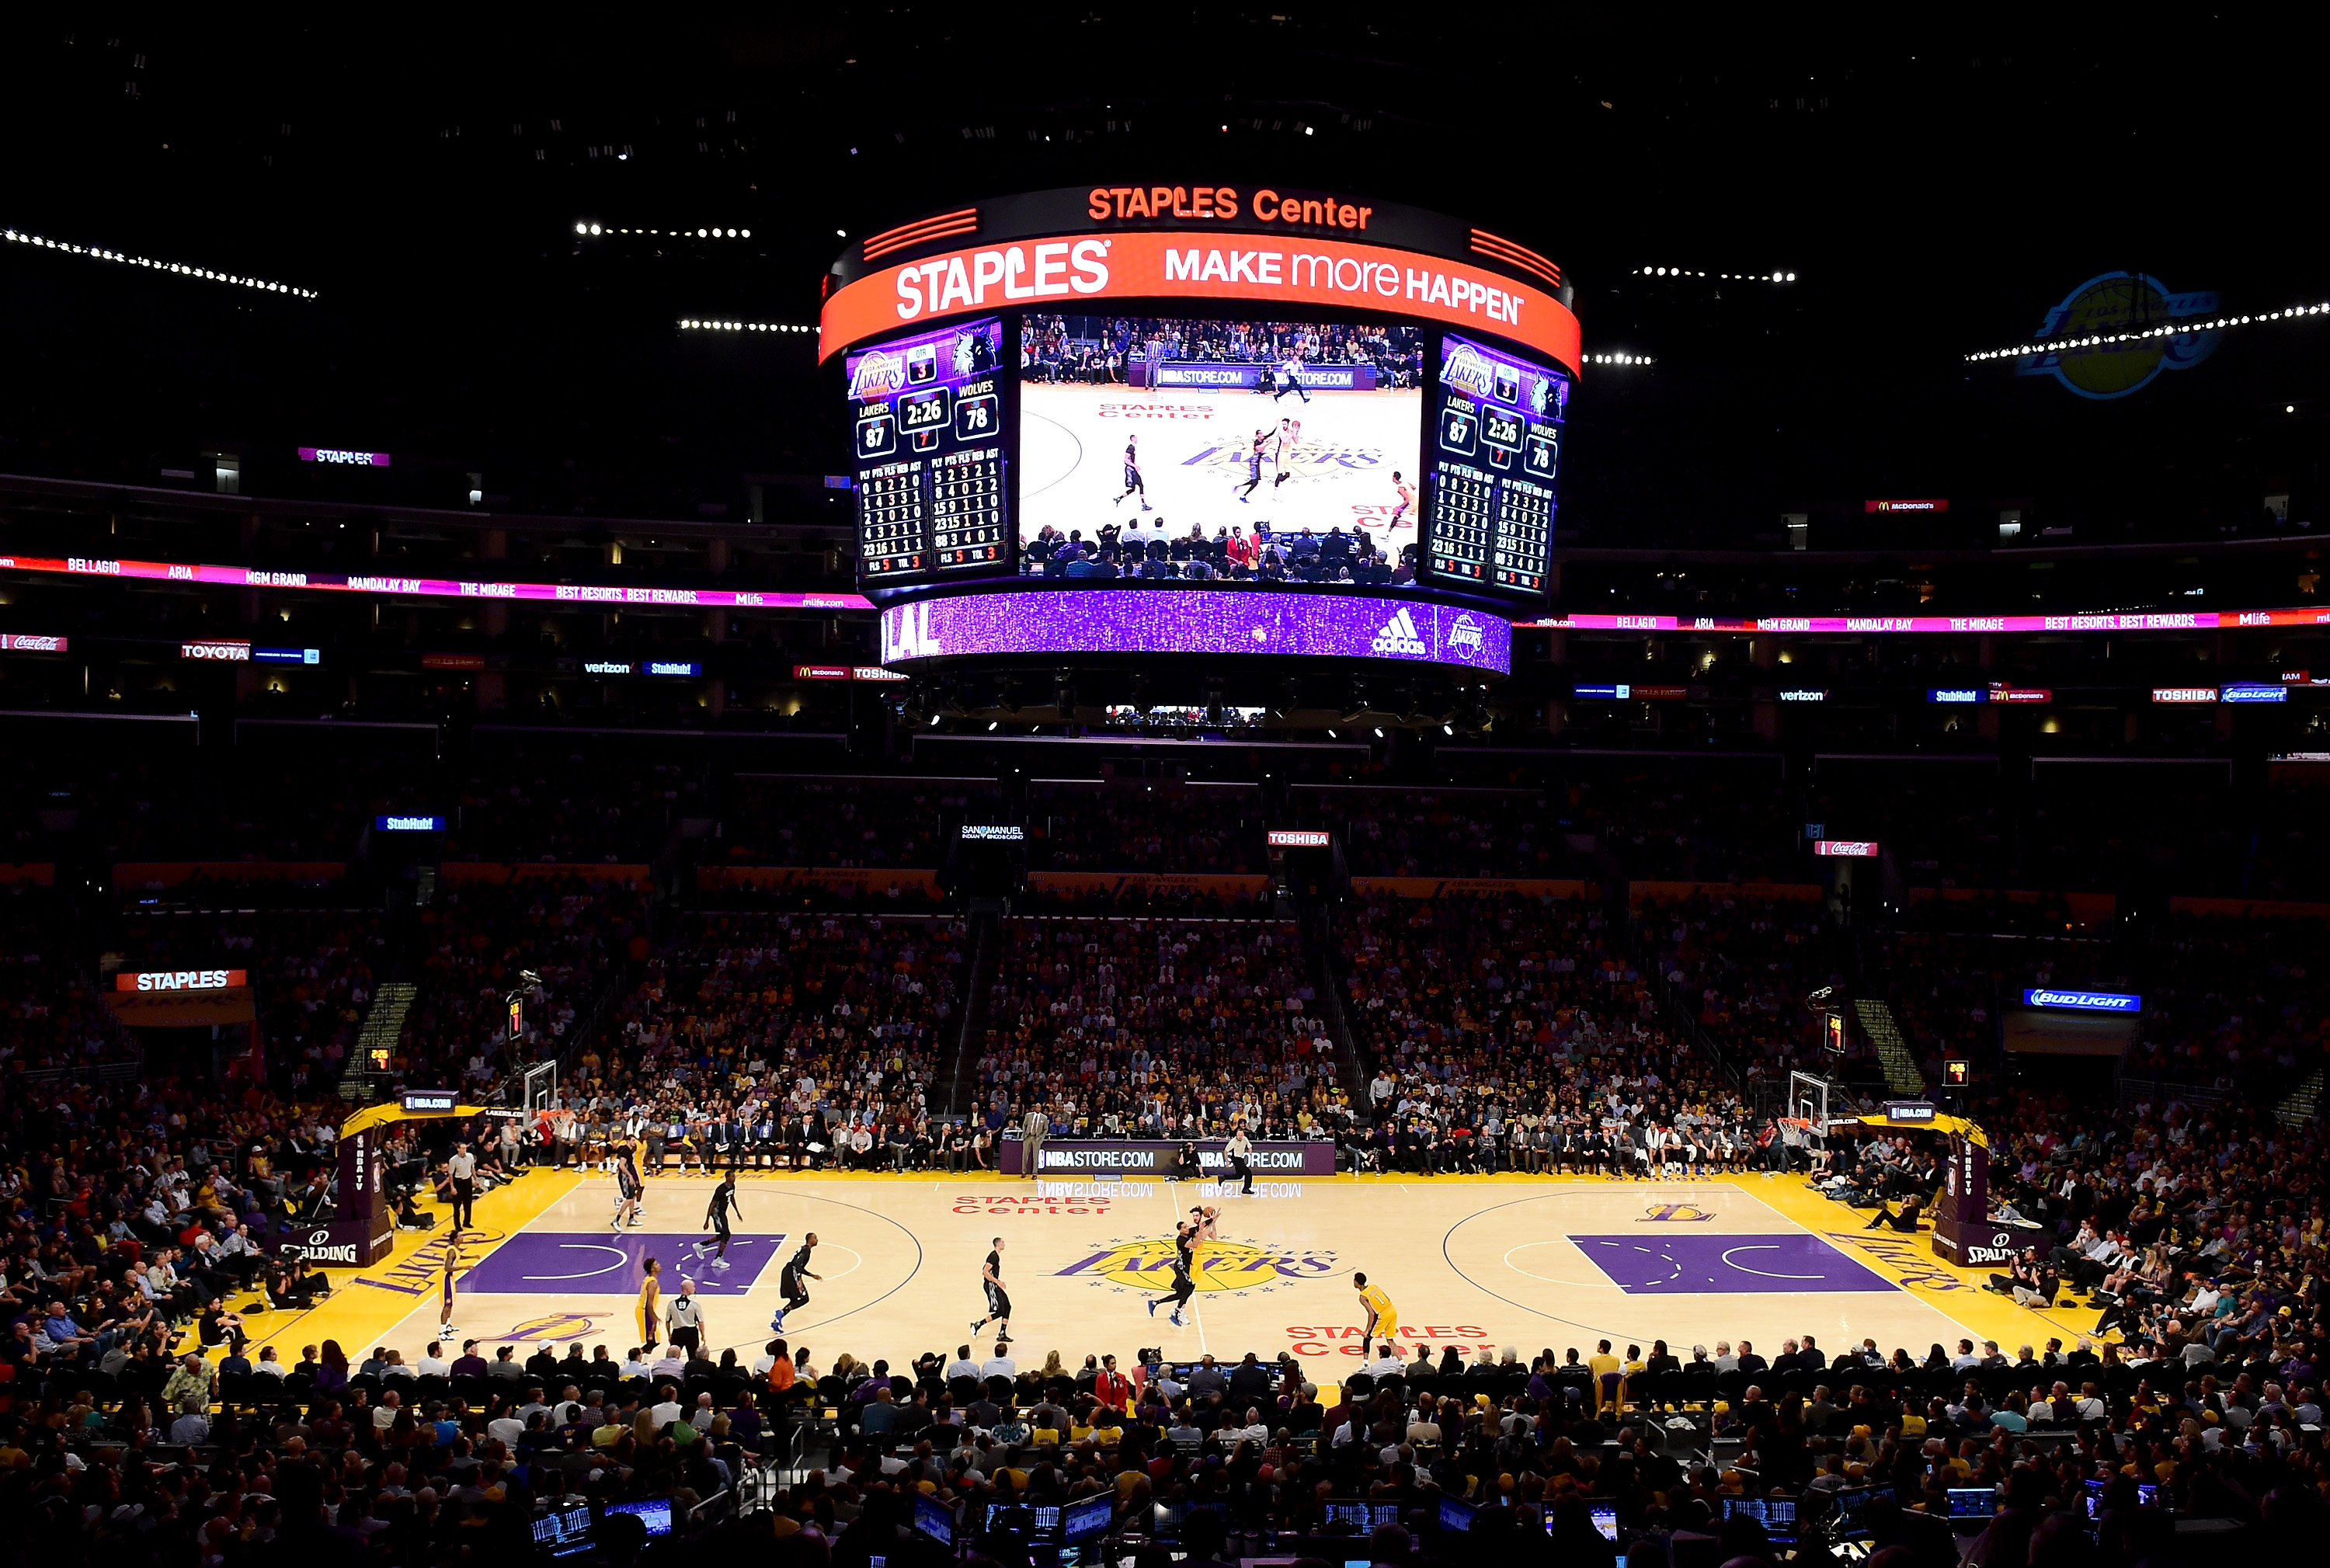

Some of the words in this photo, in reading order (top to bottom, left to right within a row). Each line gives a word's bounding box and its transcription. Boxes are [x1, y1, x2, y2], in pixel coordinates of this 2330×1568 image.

[1089, 187, 1238, 220] STAPLES
[1253, 189, 1372, 230] Center
[896, 239, 1109, 319] STAPLES
[1165, 249, 1282, 284] MAKE
[1292, 253, 1400, 297] more
[1406, 269, 1518, 325] HAPPEN
[916, 348, 927, 358] QTR
[918, 363, 927, 379] 3
[1442, 357, 1492, 397] LAKERS
[1504, 368, 1512, 378] QTR
[853, 365, 902, 398] LAKERS
[958, 381, 993, 398] WOLVES
[1503, 383, 1510, 397] 3
[859, 402, 889, 418] LAKERS
[1099, 403, 1213, 412] STAPLES
[1447, 395, 1475, 413] LAKERS
[908, 399, 941, 426] 2:26
[967, 407, 987, 430] 78
[1098, 411, 1214, 419] Center
[866, 427, 884, 447] 87
[1449, 422, 1467, 443] 87
[1488, 418, 1517, 443] 2:26
[1531, 422, 1556, 439] WOLVES
[920, 434, 927, 447] 7
[316, 449, 373, 465] STAPLES
[1497, 450, 1503, 462] 7
[1533, 447, 1549, 468] 78
[863, 483, 869, 495] 0
[875, 481, 882, 492] 8
[888, 479, 894, 491] 2
[900, 477, 906, 488] 2
[913, 475, 920, 487] 0
[864, 499, 870, 510] 1
[876, 496, 882, 508] 4
[889, 494, 895, 506] 3
[901, 492, 907, 503] 3
[913, 490, 920, 502] 1
[864, 513, 871, 525] 2
[877, 511, 883, 523] 2
[889, 509, 895, 521] 0
[902, 508, 908, 519] 2
[914, 506, 920, 517] 0
[864, 544, 875, 556] 23
[876, 542, 887, 555] 16
[891, 541, 897, 553] 1
[903, 540, 909, 551] 1
[916, 537, 923, 550] 1
[68, 558, 120, 574] BELLAGIO
[869, 561, 880, 572] FLS
[883, 558, 890, 571] 5
[898, 558, 909, 568] TOL
[913, 556, 920, 568] 3
[168, 565, 193, 579] ARIA
[245, 571, 270, 584] MGM
[272, 572, 307, 586] GRAND
[348, 576, 402, 591] MANDALAY
[402, 579, 420, 592] BAY
[460, 582, 478, 596] THE
[479, 583, 516, 596] MIRAGE
[556, 586, 579, 599] BEST
[581, 586, 624, 600] RESORTS.
[627, 588, 650, 602] BEST
[652, 589, 699, 603] REWARDS.
[736, 593, 763, 605] Mlife
[803, 599, 844, 607] mlife.com
[1537, 618, 1575, 627] mlife.com
[1617, 617, 1657, 628] BELLAGIO
[1694, 618, 1715, 630] ARIA
[1757, 619, 1779, 630] MGM
[1780, 619, 1810, 630] GRAND
[1846, 619, 1894, 630] MANDALAY
[1895, 619, 1913, 630] BAY
[1949, 618, 1967, 630] THE
[1969, 618, 2004, 630] MIRAGE
[2045, 617, 2069, 629] BEST
[2071, 616, 2117, 629] RESORTS.
[2120, 615, 2144, 628] BEST
[2147, 614, 2197, 628] REWARDS.
[2239, 613, 2270, 624] Mlife
[14, 635, 59, 651] Coca-Cola
[1447, 622, 1483, 651] LAKERS
[182, 645, 249, 660] TOYOTA
[1372, 635, 1426, 655] adidas
[585, 662, 630, 674] verizon
[651, 662, 690, 675] StubHub!
[1780, 690, 1823, 701] verizon
[1936, 691, 1976, 702] StubHub!
[2153, 690, 2216, 701] TOSHIBA
[387, 816, 433, 830] StubHub!
[1269, 833, 1327, 845] TOSHIBA
[1831, 842, 1870, 855] Coca-Cola
[137, 970, 228, 991] STAPLES
[2040, 993, 2078, 1004] BUD
[2077, 996, 2131, 1007] LIGHT
[415, 1098, 451, 1108] NBA.COM
[1900, 1109, 1932, 1118] NBA.COM
[1045, 1151, 1153, 1167] NBASTORE.COM
[356, 1175, 363, 1191] TV
[1965, 1180, 1972, 1195] TV
[955, 1196, 1111, 1205] STAPLES
[952, 1205, 1111, 1215] Center
[280, 1244, 357, 1264] ALDING
[1820, 1229, 1978, 1295] LAKERS
